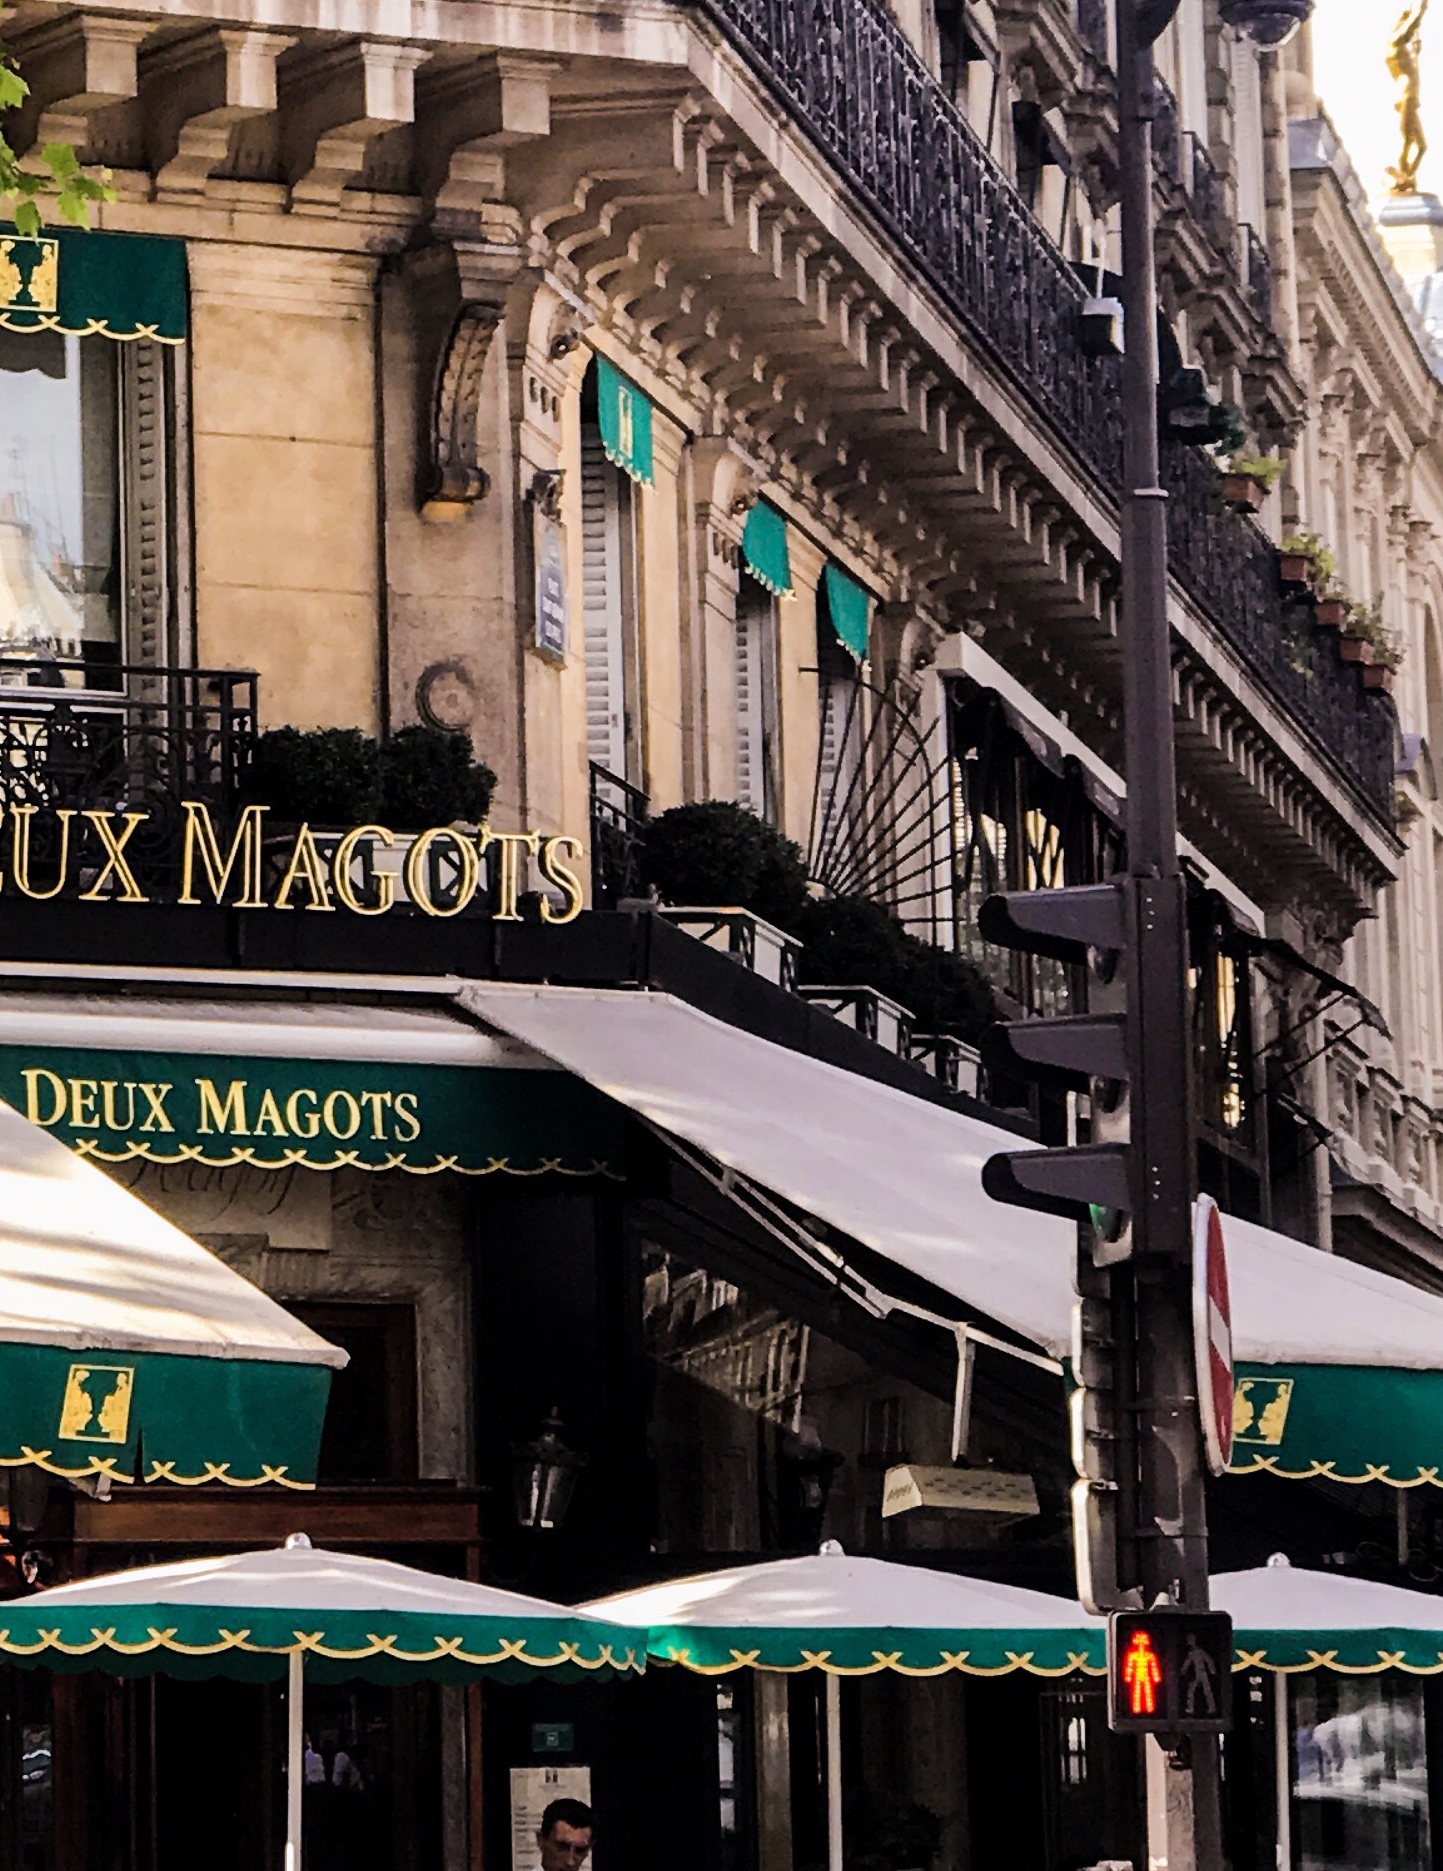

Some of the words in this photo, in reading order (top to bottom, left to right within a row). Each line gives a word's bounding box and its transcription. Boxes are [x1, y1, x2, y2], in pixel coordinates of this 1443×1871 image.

[177, 801, 584, 925] MAGOTS
[21, 1067, 175, 1132] DEUX
[194, 1077, 421, 1142] MAGOTS
